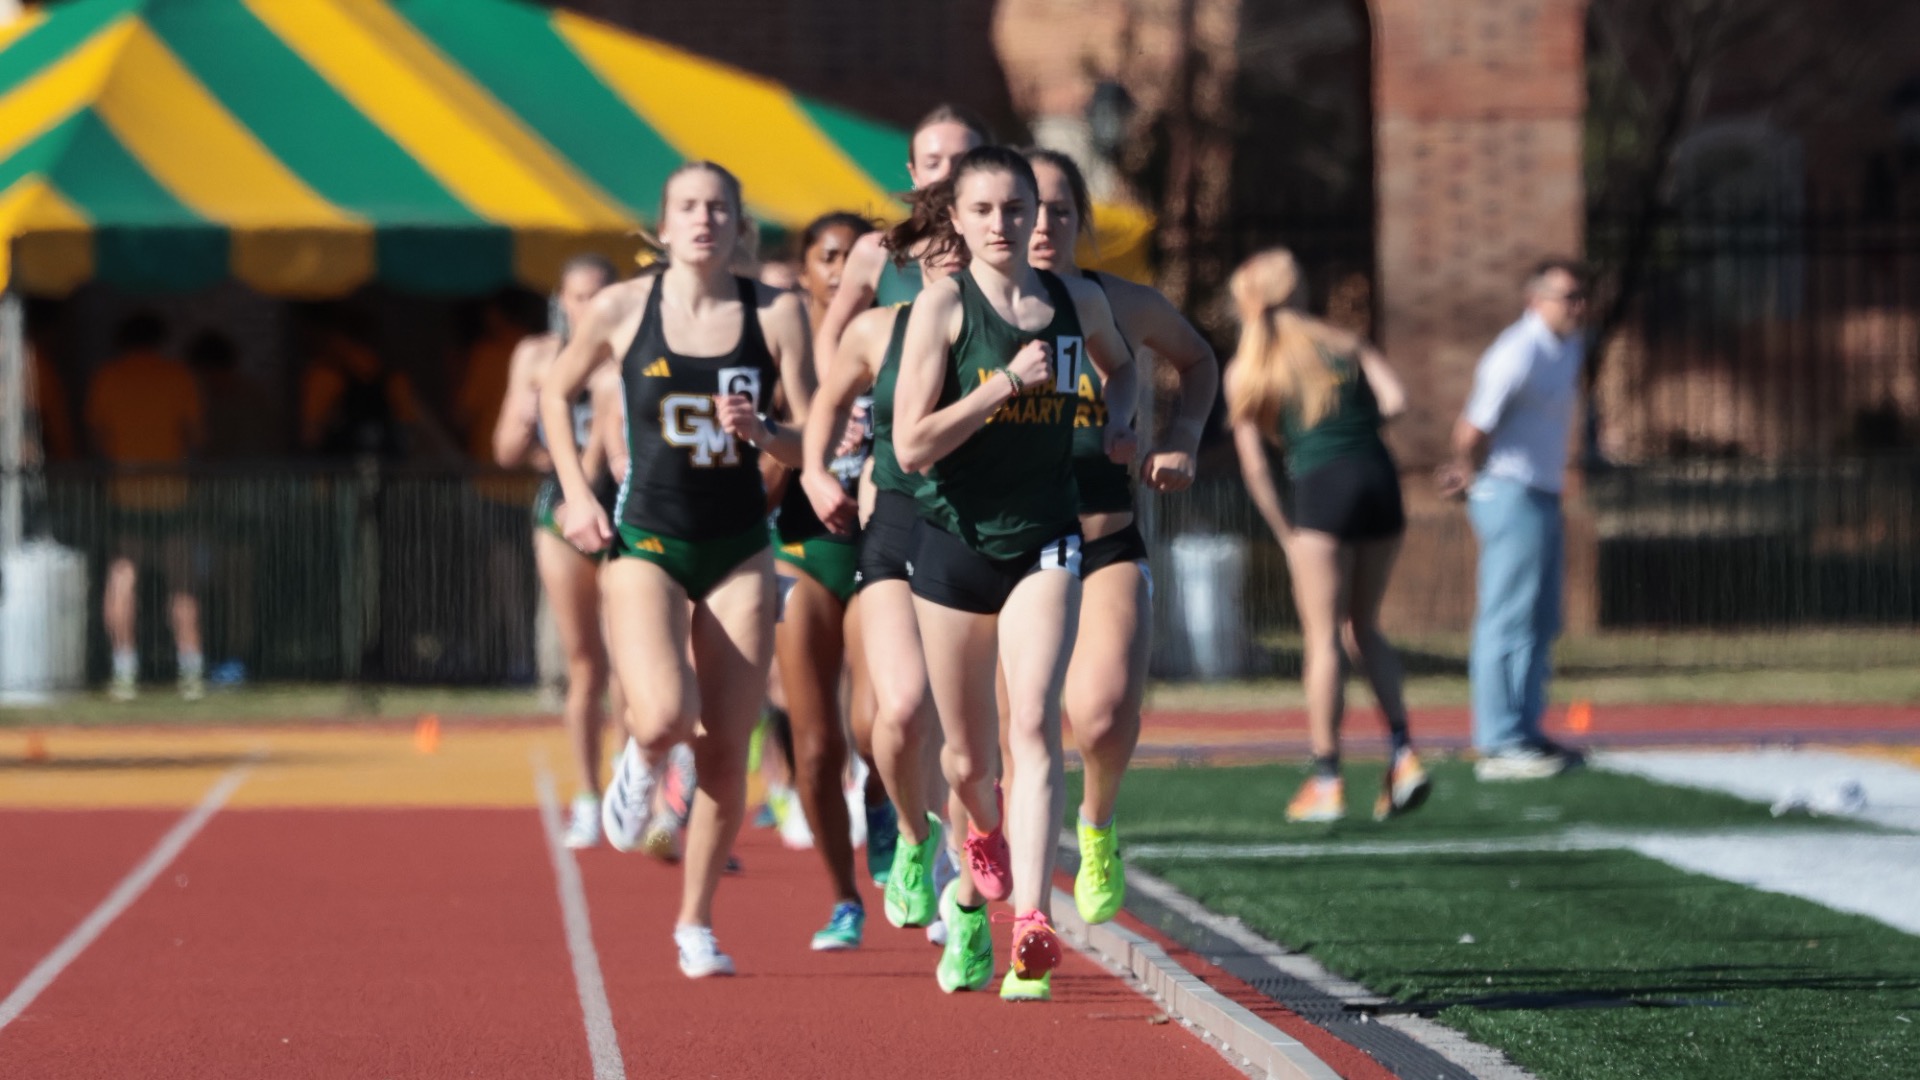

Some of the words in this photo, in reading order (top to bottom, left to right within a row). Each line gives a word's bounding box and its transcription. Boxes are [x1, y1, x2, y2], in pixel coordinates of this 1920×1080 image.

[1063, 341, 1077, 390] 1
[661, 394, 740, 467] GM
[999, 397, 1066, 424] MARY
